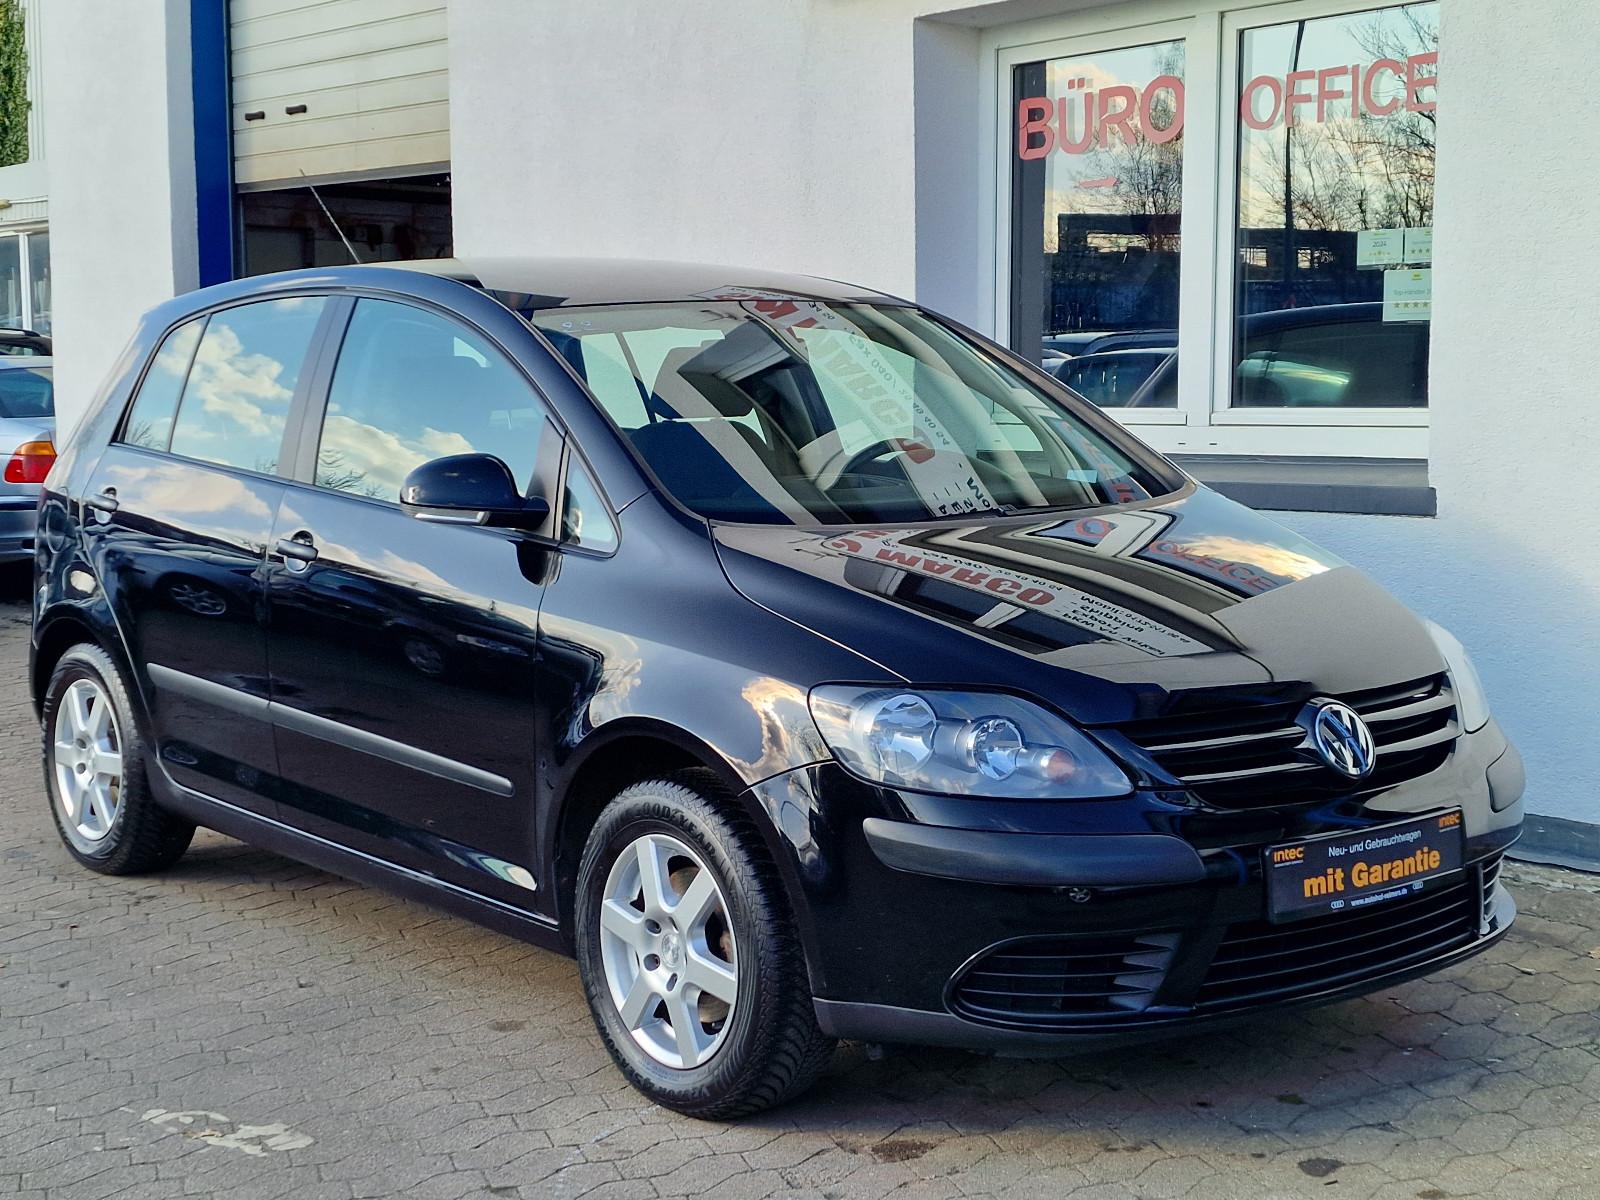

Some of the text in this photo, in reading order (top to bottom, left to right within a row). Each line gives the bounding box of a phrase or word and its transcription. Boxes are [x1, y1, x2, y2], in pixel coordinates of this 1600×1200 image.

[1018, 51, 1439, 161] BÜRO OFFICE
[1274, 847, 1304, 862] intec
[1328, 845, 1348, 858] Neu-
[1349, 841, 1364, 854] und
[1303, 846, 1441, 898] mit Garantie
